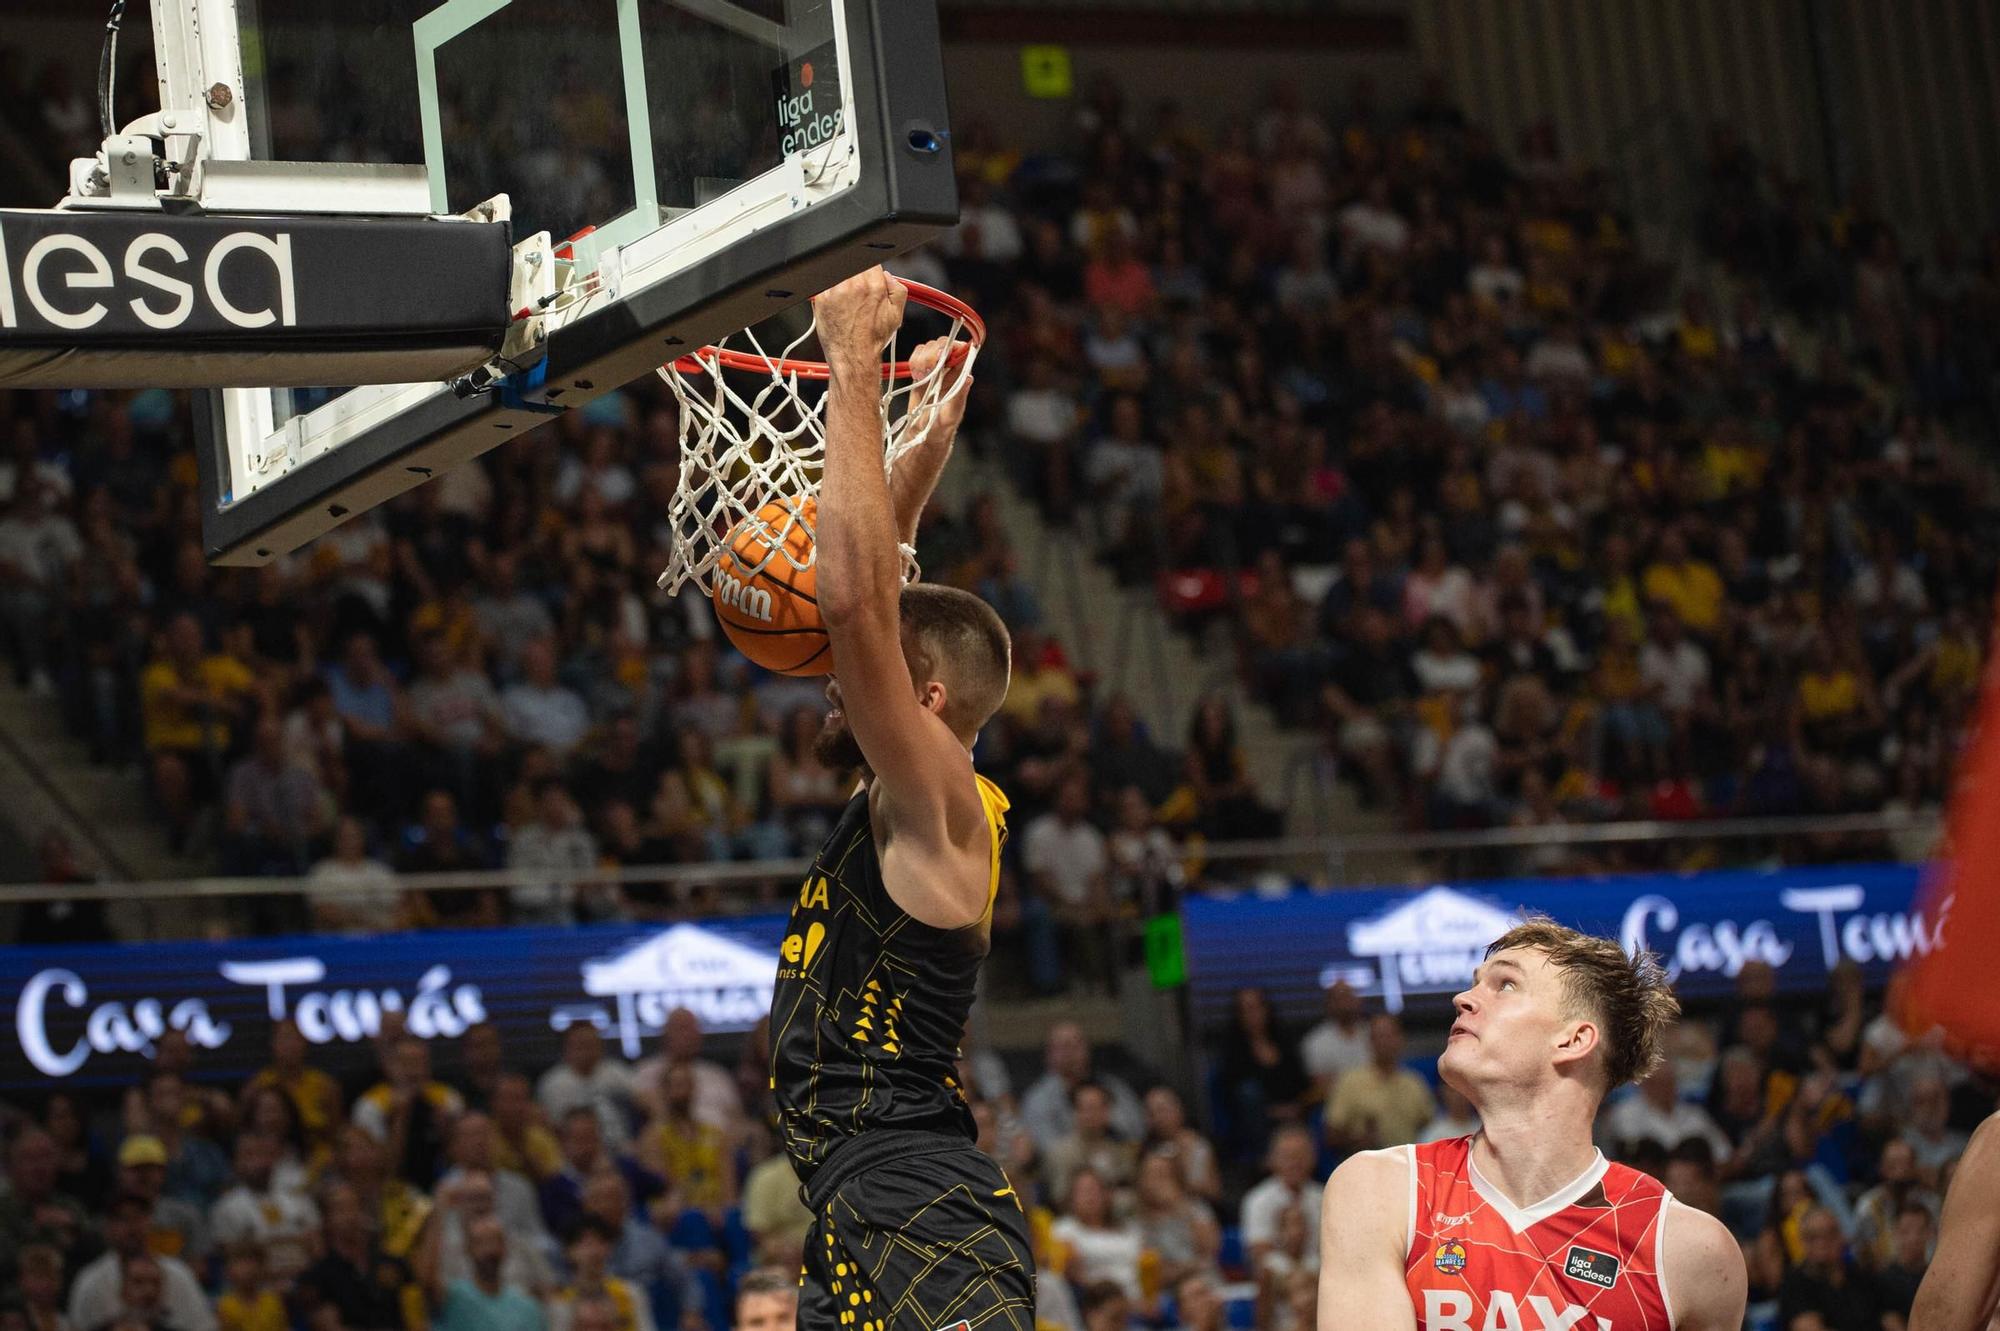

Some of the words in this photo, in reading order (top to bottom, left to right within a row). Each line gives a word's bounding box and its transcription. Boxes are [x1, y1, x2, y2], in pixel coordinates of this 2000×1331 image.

[778, 90, 813, 127] liga
[1621, 894, 1795, 985] Casa
[1569, 1266, 1612, 1284] endesa
[1571, 1256, 1592, 1269] liga
[1421, 1289, 1612, 1331] BAX
